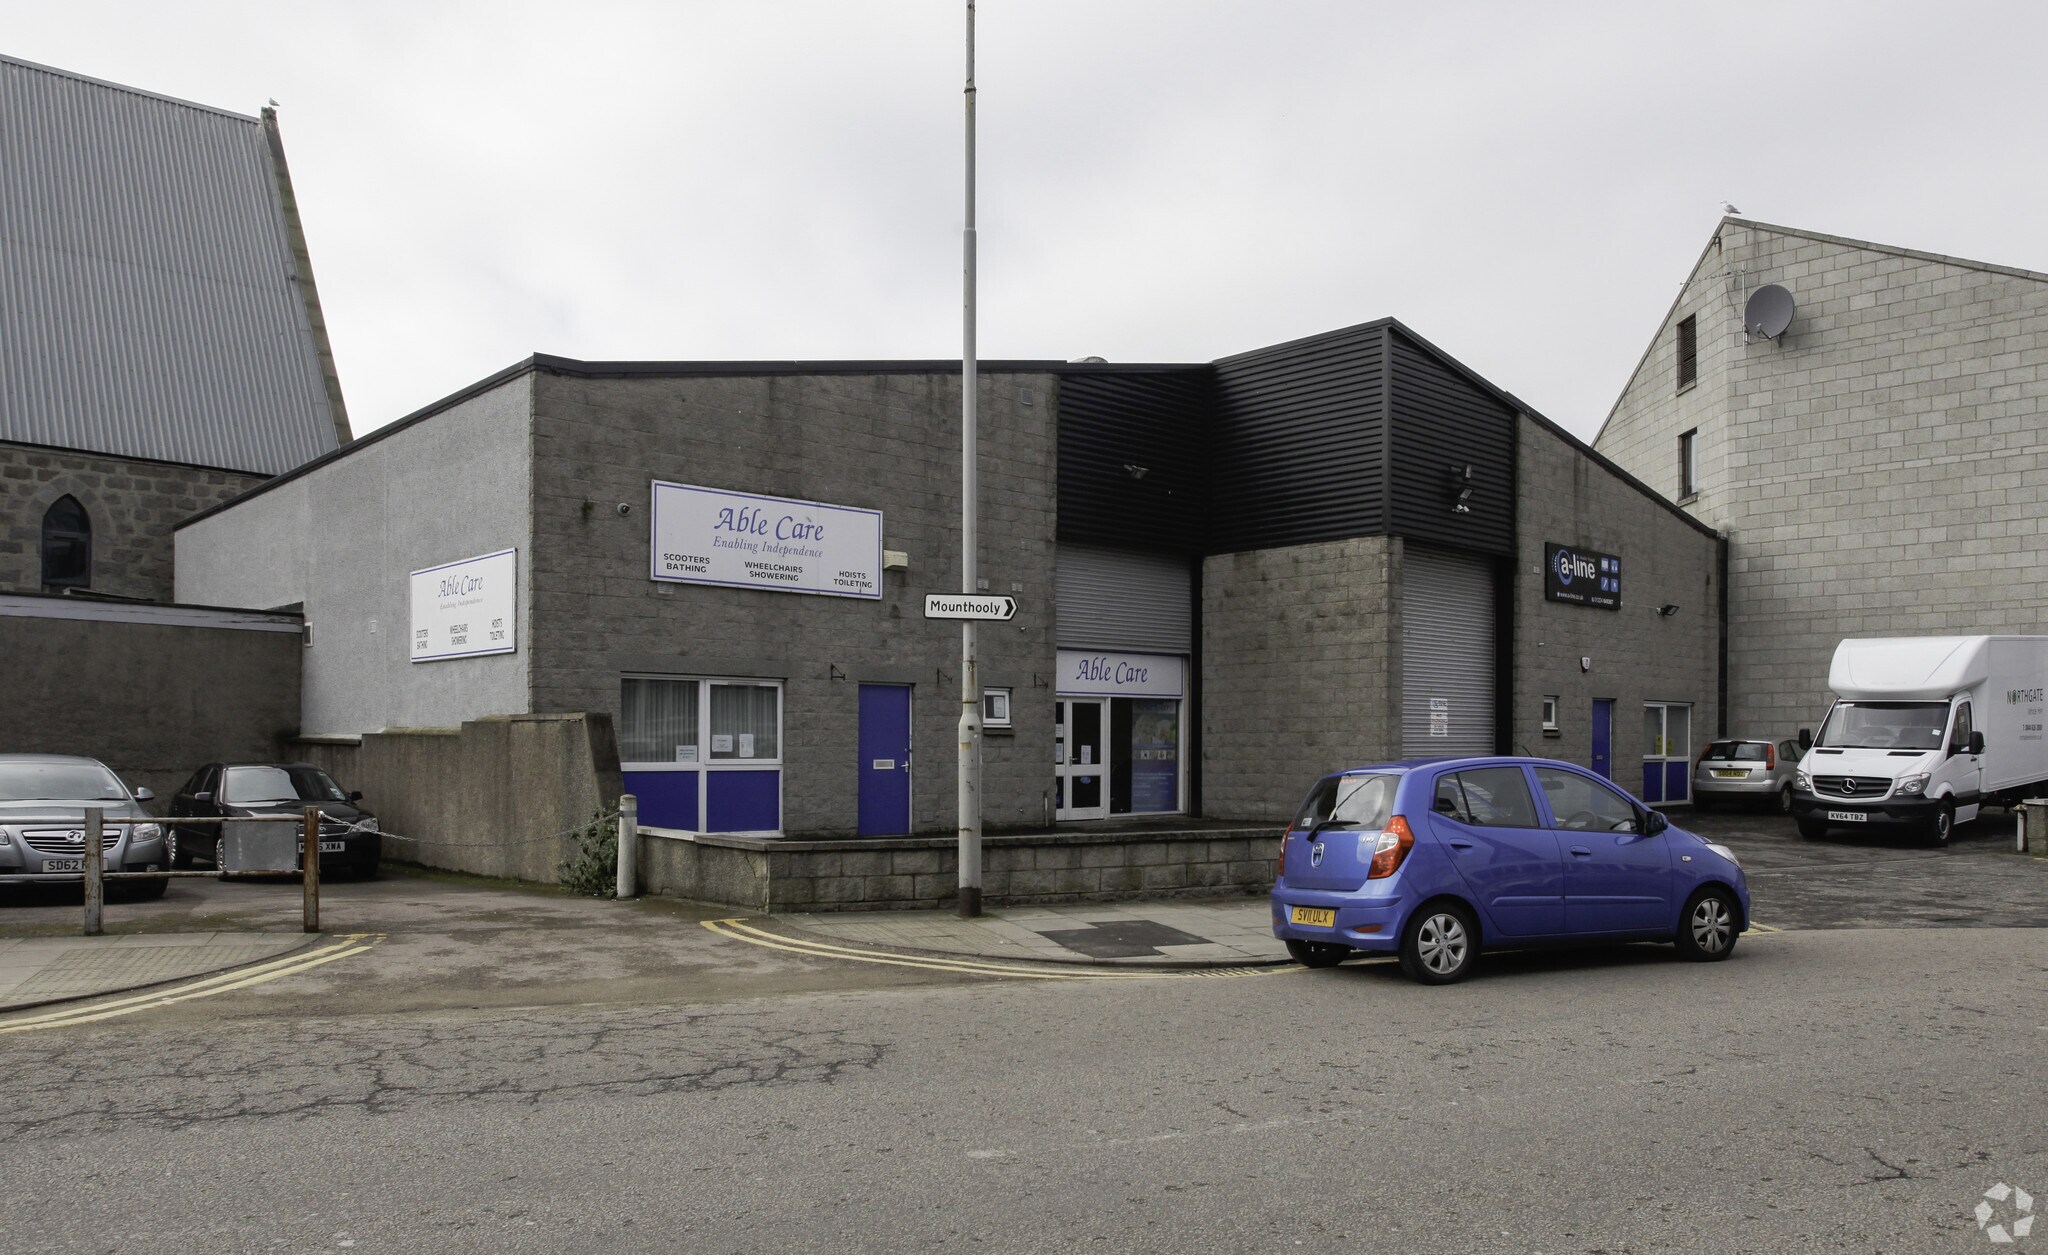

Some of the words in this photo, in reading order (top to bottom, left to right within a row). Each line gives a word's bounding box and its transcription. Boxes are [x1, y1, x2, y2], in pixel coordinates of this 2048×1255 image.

[713, 506, 768, 536] Able
[775, 515, 824, 541] Care
[712, 536, 758, 554] Enabling
[762, 541, 824, 559] Independence
[663, 553, 711, 565] SCOOTERS
[666, 562, 707, 574] BATHING
[744, 561, 803, 574] WHEELCHAIRS
[1561, 554, 1595, 579] a-line
[749, 570, 800, 582] SHOWERING
[838, 570, 867, 580] HOISTS
[438, 575, 459, 598] Able
[461, 576, 483, 596] Care
[833, 578, 873, 589] TOILETING
[930, 600, 1001, 615] Mounthooly
[1076, 657, 1111, 681] Able
[1115, 661, 1148, 685] Care
[2006, 688, 2044, 706] NORTHGATE
[48, 860, 79, 871] SD62
[1313, 910, 1329, 923] ULX
